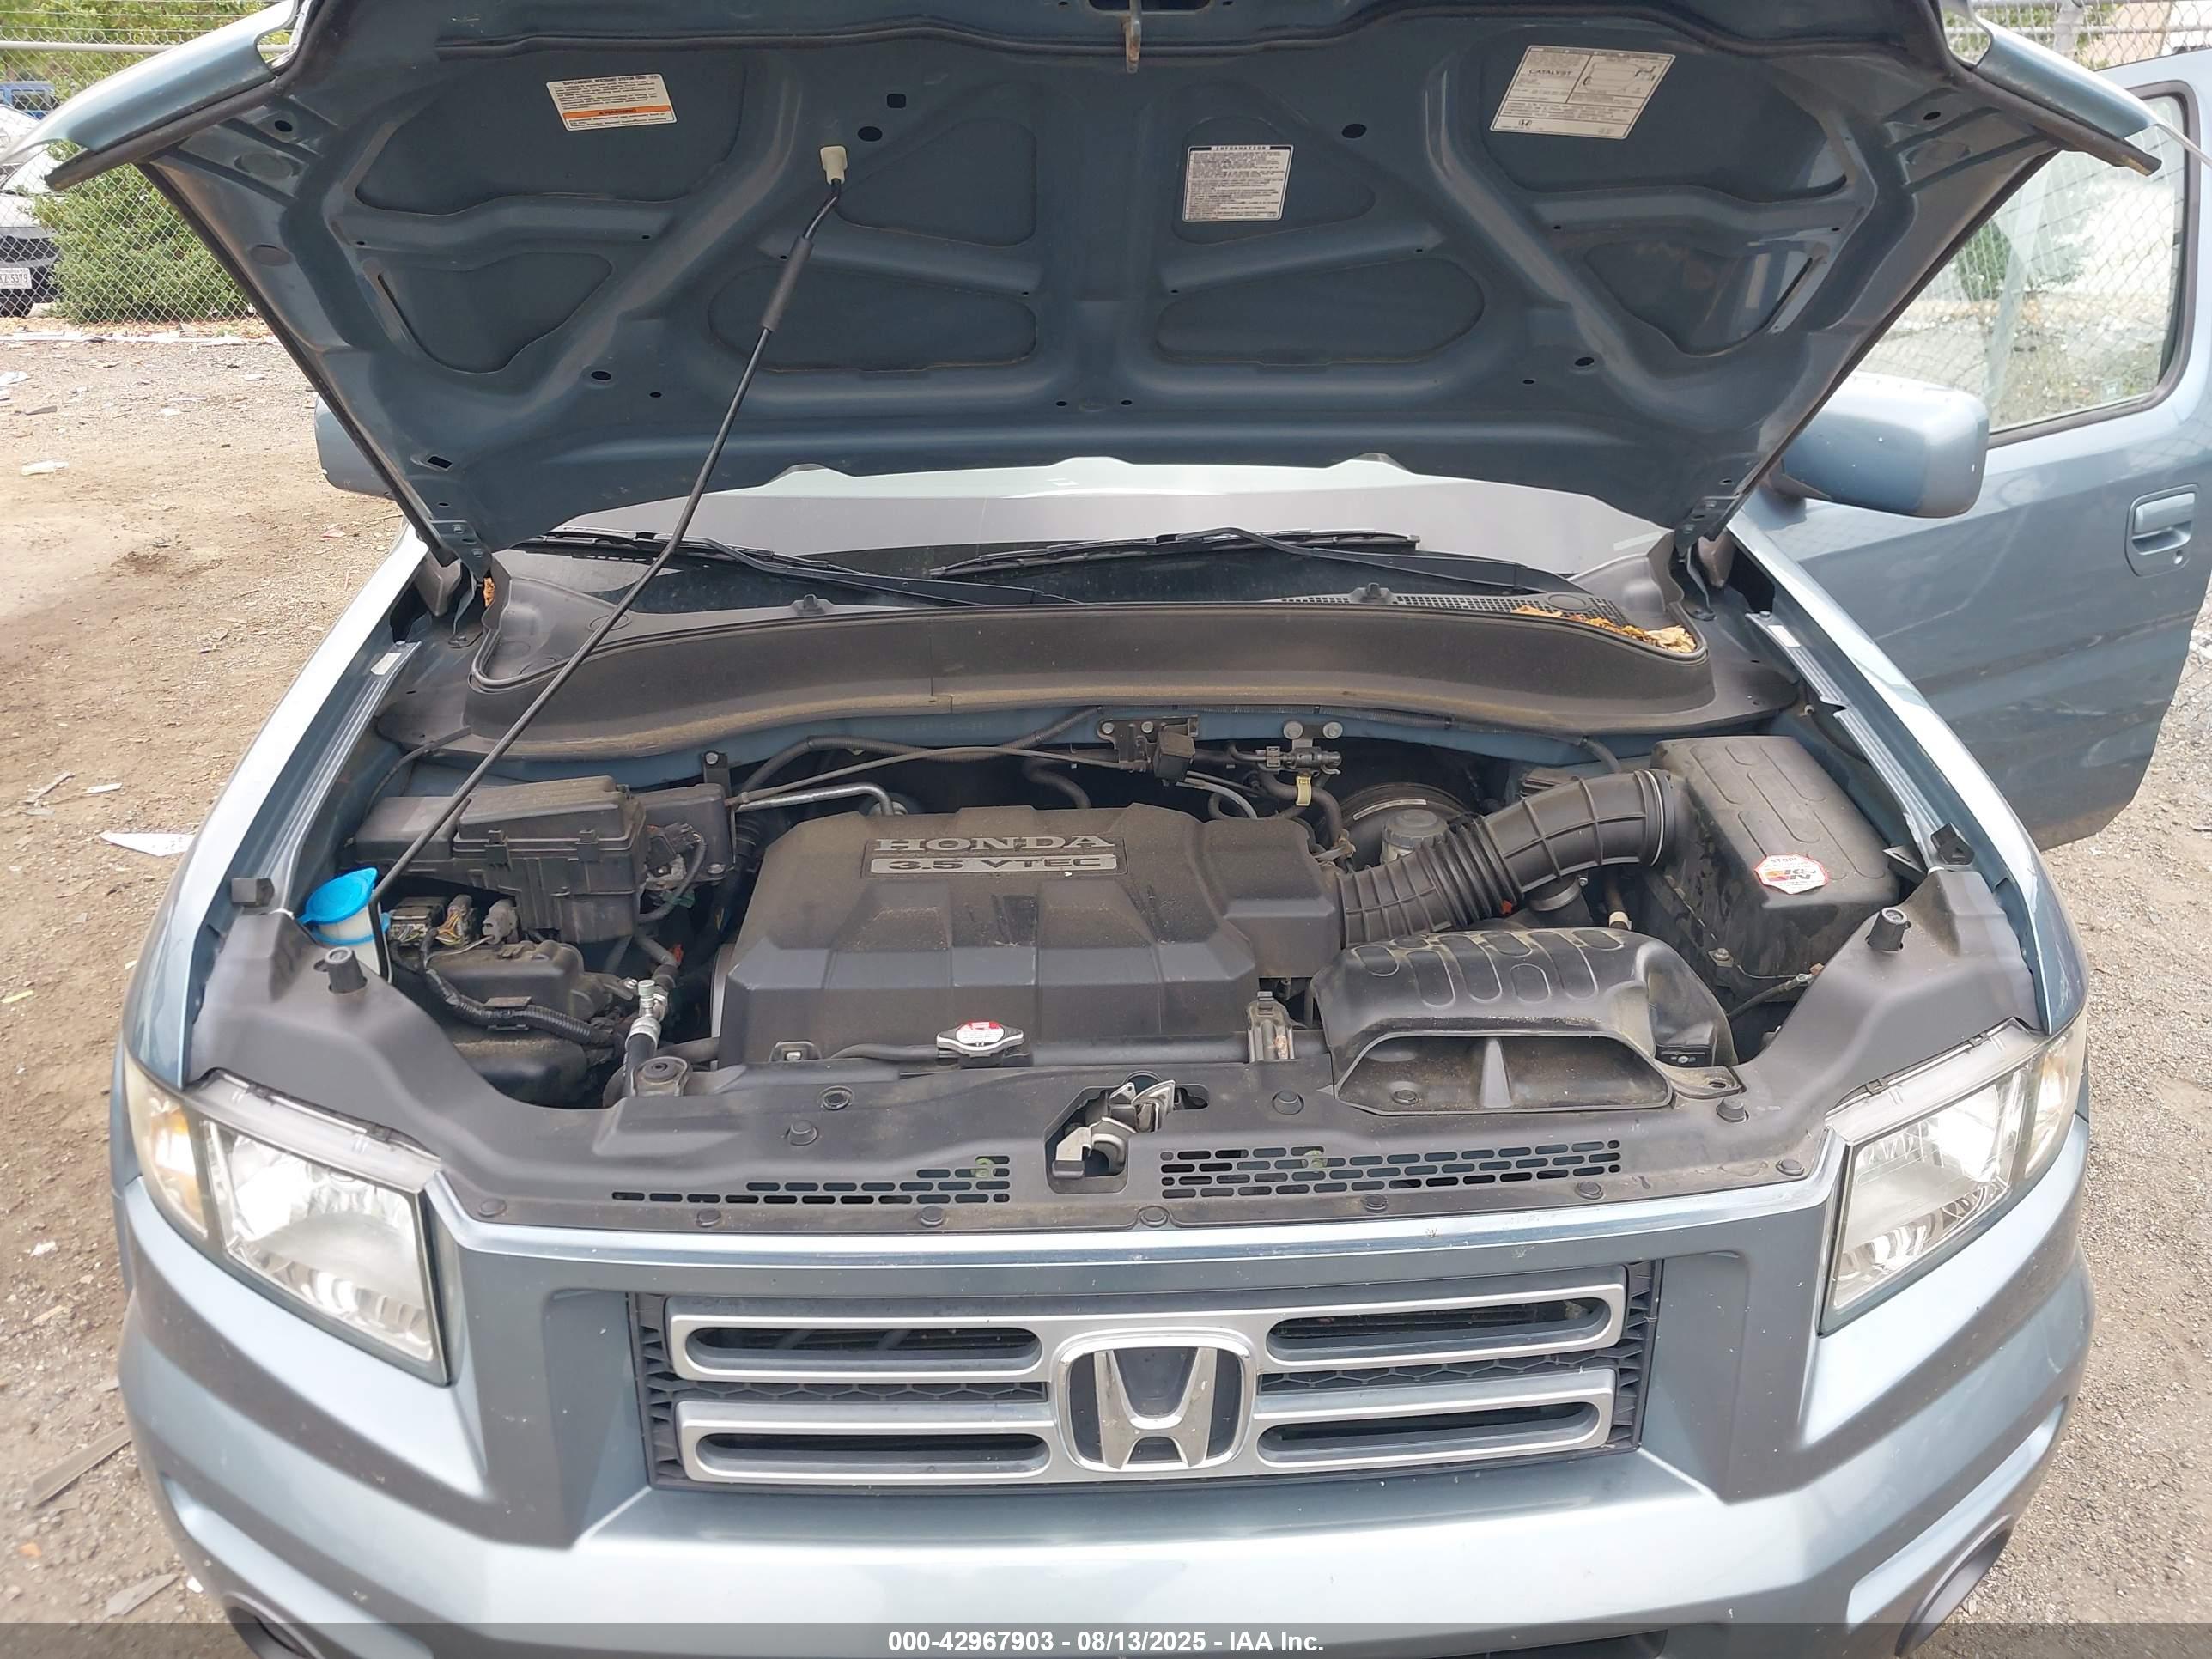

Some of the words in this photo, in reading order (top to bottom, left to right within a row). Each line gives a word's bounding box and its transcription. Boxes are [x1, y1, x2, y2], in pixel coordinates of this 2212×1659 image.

[1528, 68, 1573, 76] CATALYST
[874, 835, 1115, 852] HONDA
[888, 860, 964, 871] 3.5
[980, 858, 1102, 869] VTEC
